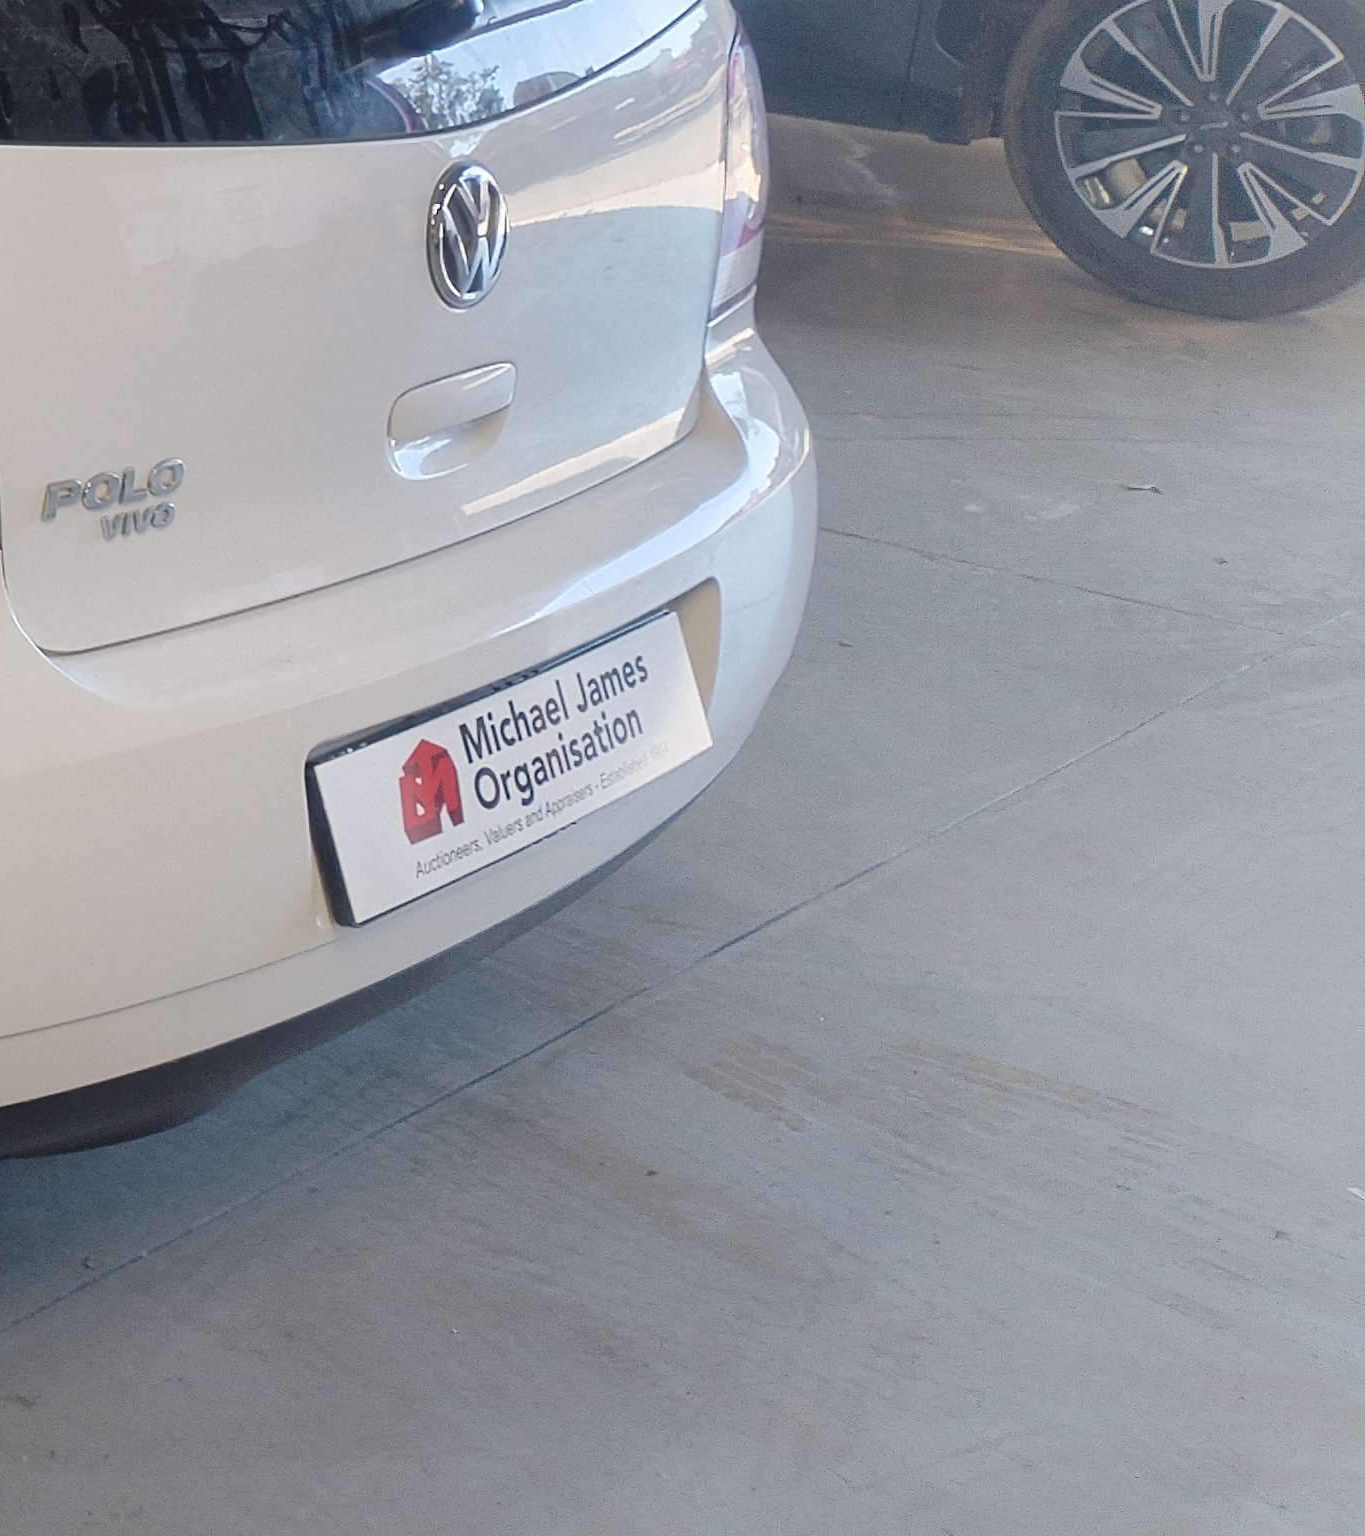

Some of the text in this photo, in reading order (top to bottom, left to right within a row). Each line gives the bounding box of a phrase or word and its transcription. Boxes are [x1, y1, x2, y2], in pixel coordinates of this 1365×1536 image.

[41, 457, 185, 522] POLO
[100, 502, 177, 542] VIVO
[459, 655, 649, 764] Michael James
[474, 709, 644, 810] Organisation
[483, 817, 523, 847] Valuers
[525, 805, 543, 827] and
